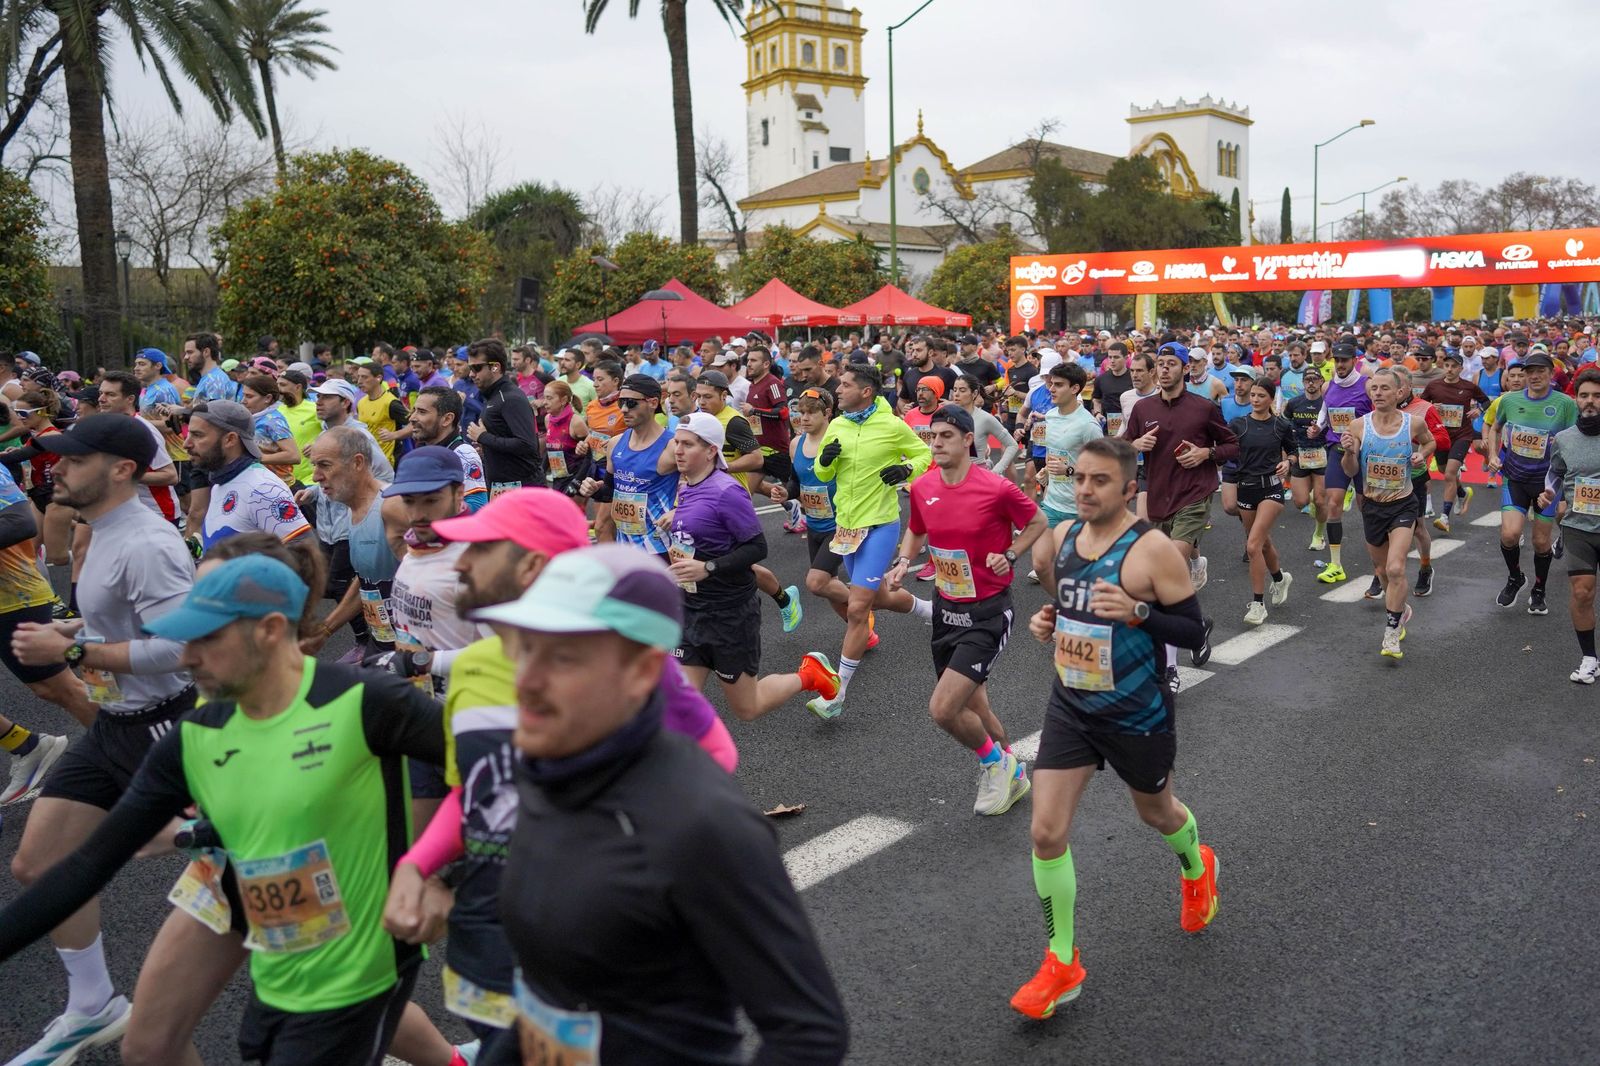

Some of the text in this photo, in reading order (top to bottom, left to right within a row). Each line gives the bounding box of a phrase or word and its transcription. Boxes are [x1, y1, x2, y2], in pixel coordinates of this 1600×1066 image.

[1430, 251, 1486, 269] HOKA
[1516, 433, 1539, 446] 4492
[1373, 464, 1398, 476] 6536
[614, 502, 636, 517] 4663
[941, 608, 973, 628] 226ERS
[1060, 636, 1095, 662] 4442
